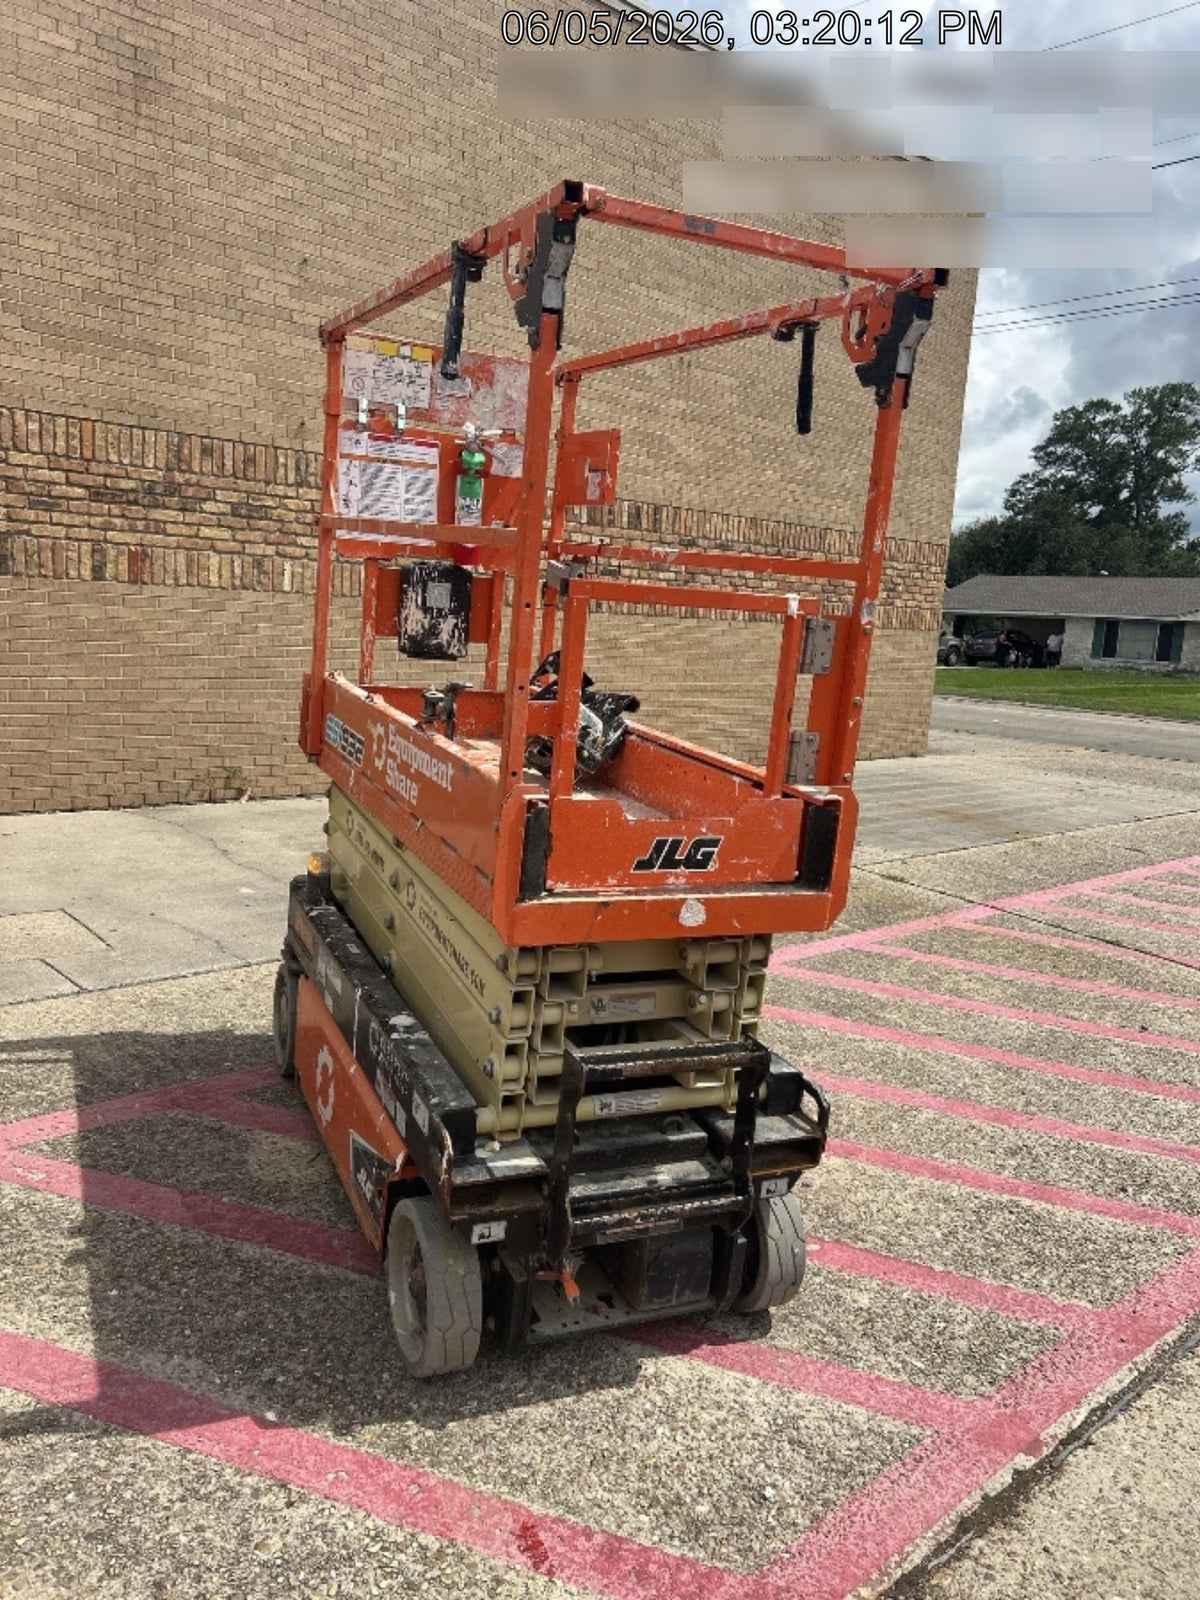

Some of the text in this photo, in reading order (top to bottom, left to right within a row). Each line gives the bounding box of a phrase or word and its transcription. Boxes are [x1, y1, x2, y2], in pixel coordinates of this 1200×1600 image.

[387, 722, 455, 793] Equipment
[386, 758, 419, 806] Share
[630, 835, 724, 873] JLG
